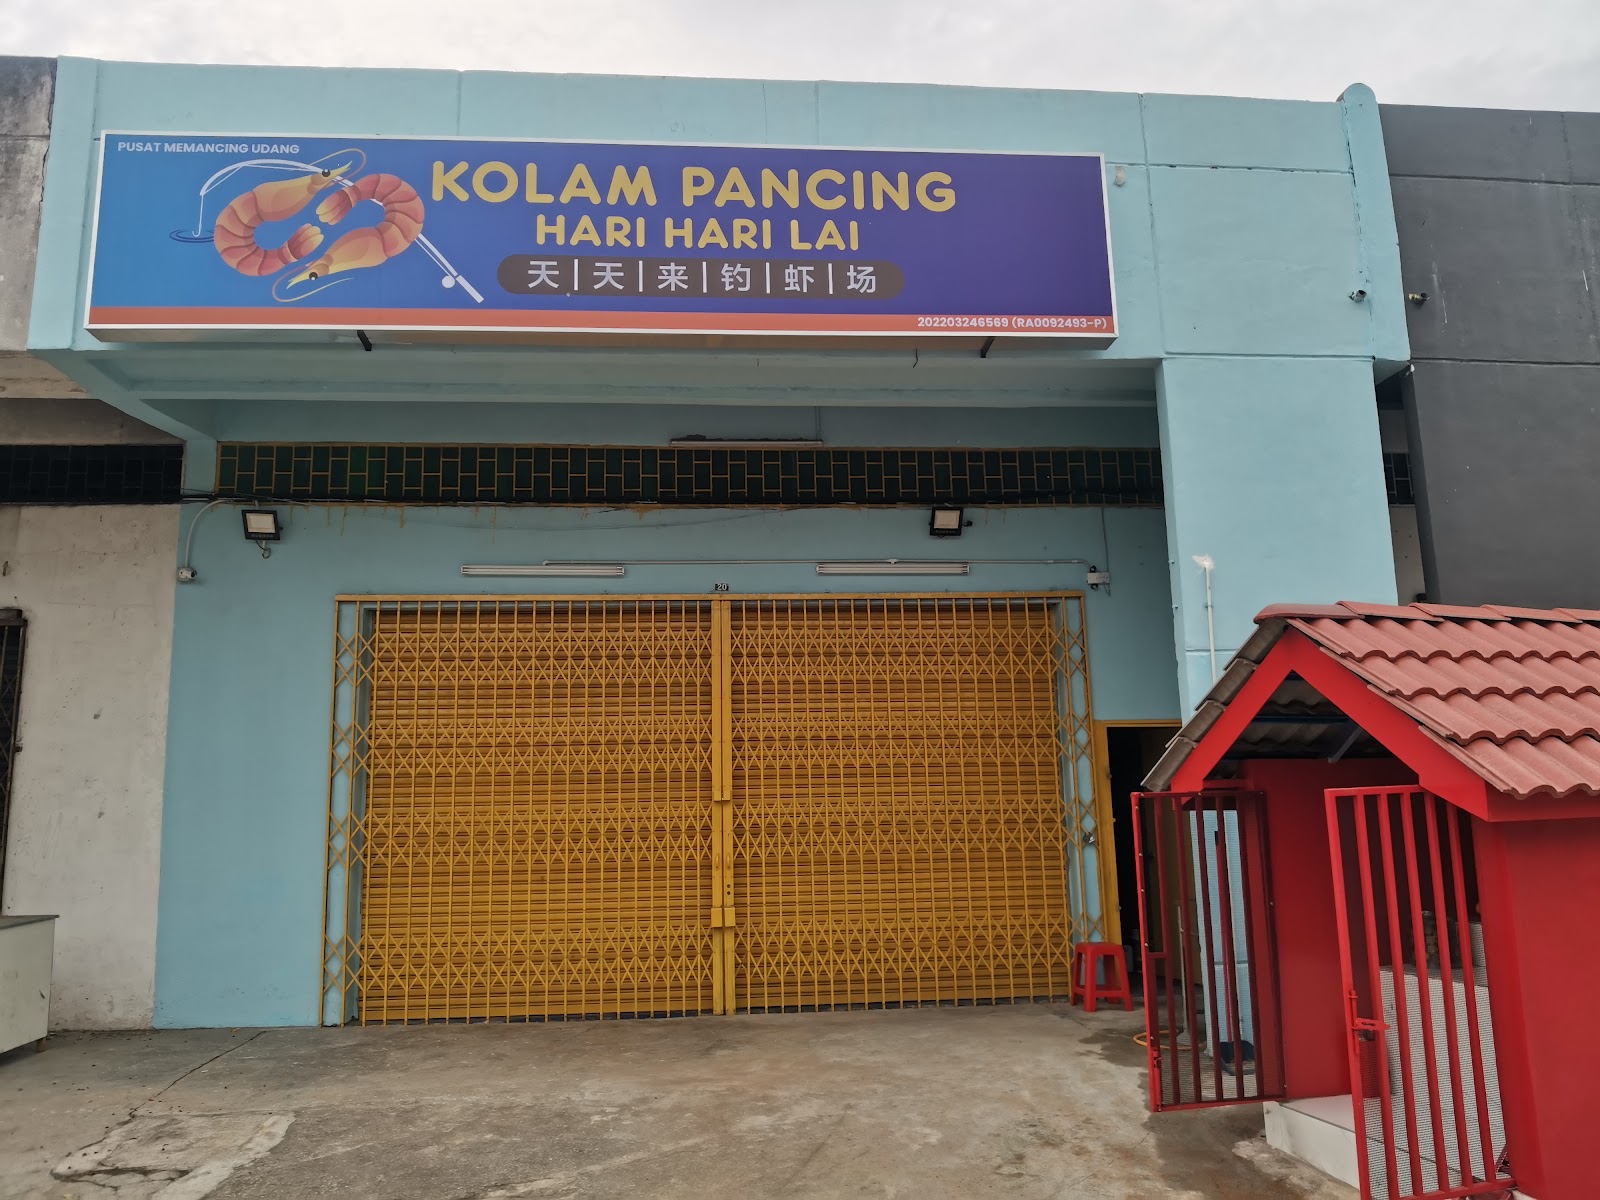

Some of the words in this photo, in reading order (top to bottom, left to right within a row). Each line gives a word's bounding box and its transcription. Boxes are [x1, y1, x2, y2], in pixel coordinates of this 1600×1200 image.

[117, 141, 162, 152] PUSAT
[163, 142, 249, 154] MEMANCING
[251, 143, 300, 154] UDANG
[431, 160, 657, 207] KOLAM
[681, 166, 956, 212] PANCING
[535, 213, 646, 248] HARI
[664, 217, 772, 251] HARI
[790, 219, 859, 251] LAI
[917, 316, 1009, 328] 202203246569
[1011, 317, 1107, 329] (RA0092493-P)
[717, 583, 727, 591] 20
